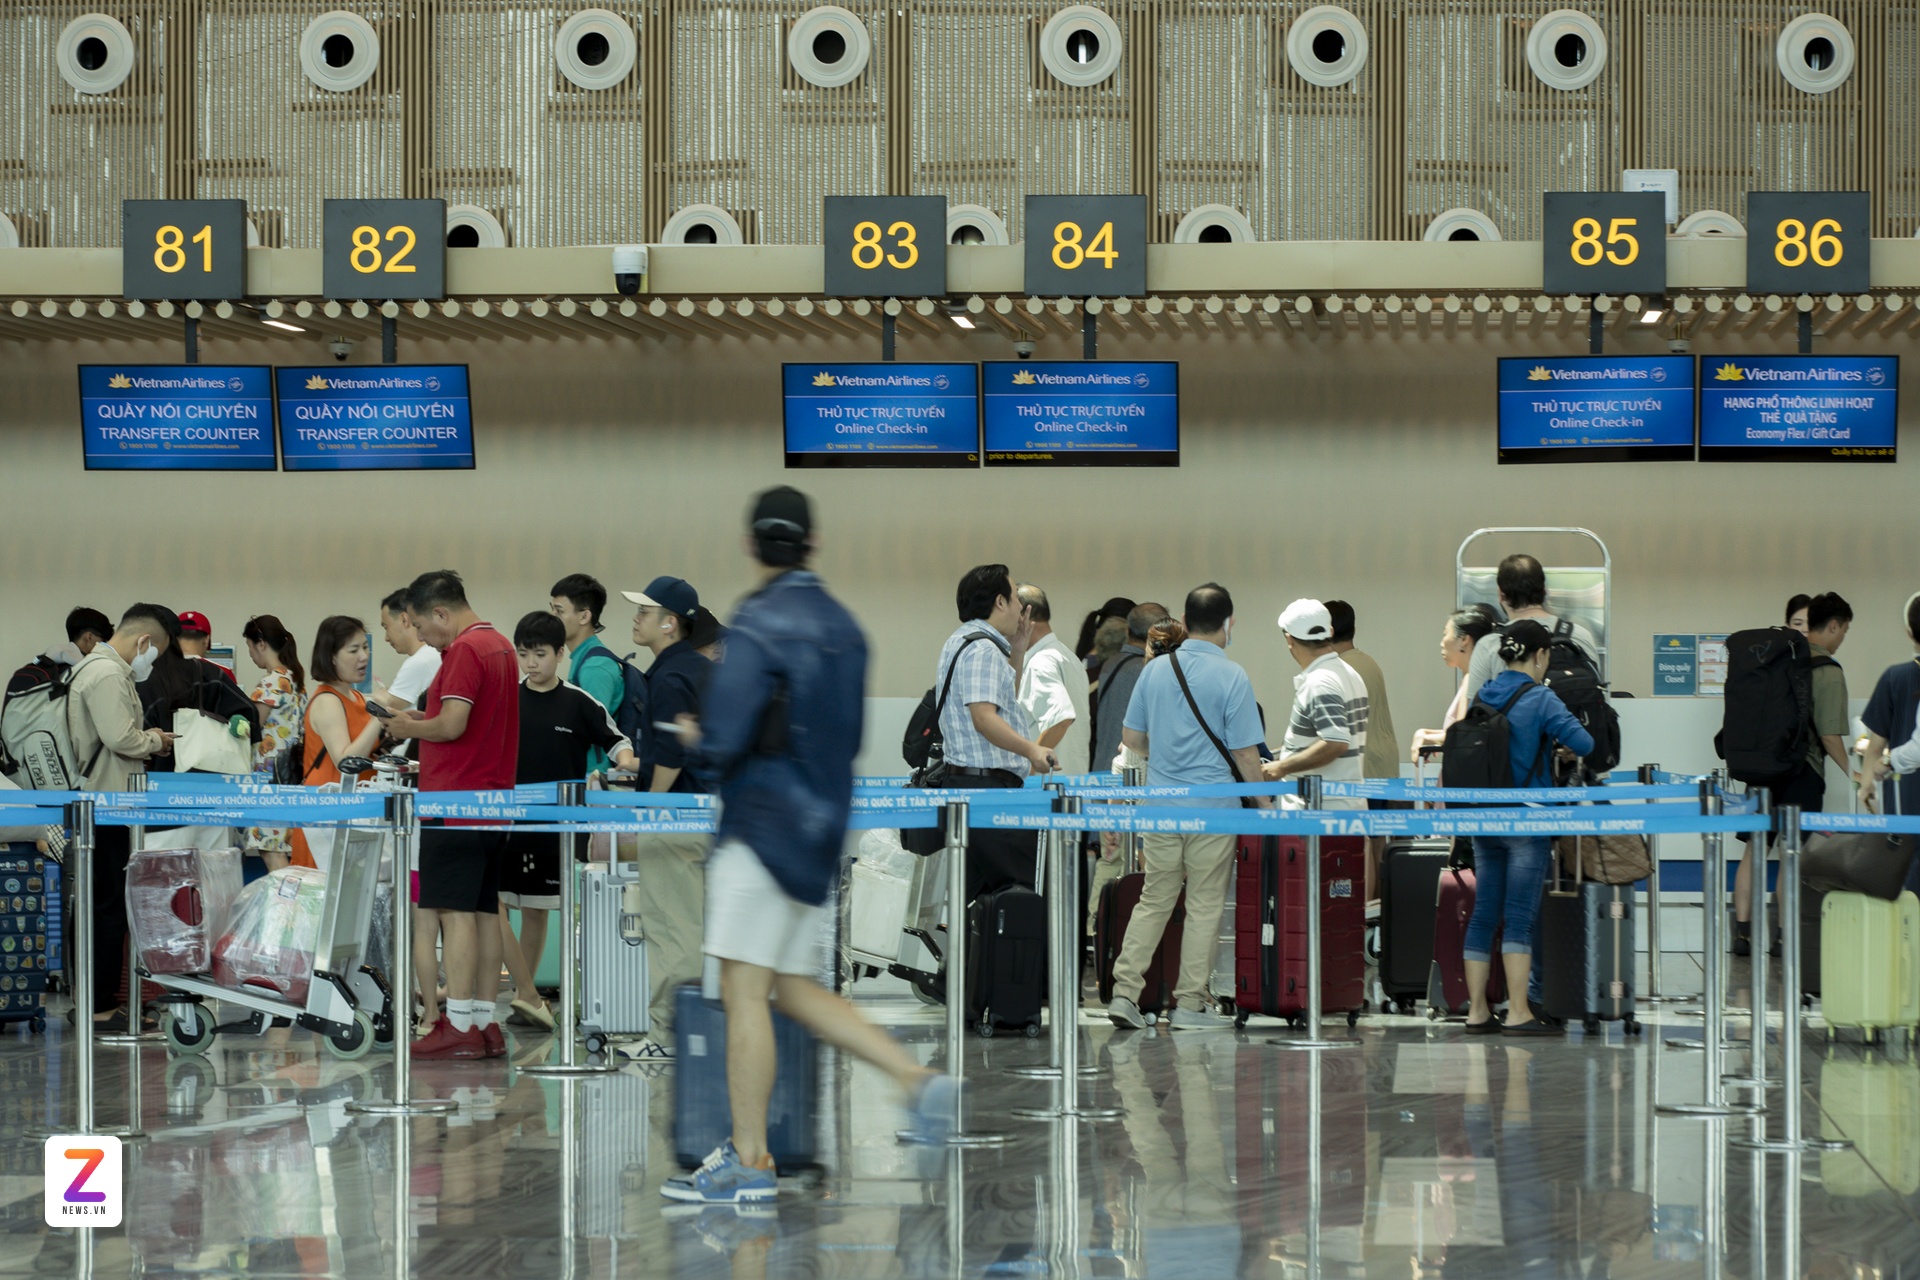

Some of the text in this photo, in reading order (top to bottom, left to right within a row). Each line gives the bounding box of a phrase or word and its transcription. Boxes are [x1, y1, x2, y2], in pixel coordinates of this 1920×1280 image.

[851, 221, 919, 269] 83
[1051, 221, 1119, 269] 84
[1570, 218, 1640, 266] 85
[1774, 218, 1844, 267] 86
[153, 225, 212, 273] 81
[349, 225, 417, 273] 82
[1531, 399, 1558, 413] THỦ
[1559, 401, 1585, 414] TỤC
[1621, 398, 1662, 412] TUYẾN
[1723, 397, 1755, 411] HẠNG
[1780, 395, 1818, 409] THÔNG
[1819, 397, 1844, 409] LINH
[1845, 397, 1875, 411] HOẠT
[816, 405, 842, 418] THỦ
[844, 407, 869, 420] TỤC
[905, 405, 946, 418] TUYẾN
[1016, 403, 1042, 417] THỦ
[1044, 405, 1069, 419] TỤC
[1104, 403, 1145, 417] TUYẾN
[1783, 410, 1807, 425] QUÀ
[835, 423, 928, 434] Online Check-in
[1034, 421, 1128, 432] Online Check-in
[1550, 416, 1644, 429] Online Check-in
[99, 427, 260, 440] TRANSFER COUNTER
[296, 427, 458, 441] TRANSFER COUNTER
[1746, 427, 1785, 441] Economy
[1787, 427, 1806, 439] Flex
[1811, 427, 1829, 439] Gift
[1829, 427, 1851, 439] Card
[988, 453, 1005, 461] prior
[1664, 675, 1686, 683] Closed
[221, 775, 254, 784] TIA
[865, 779, 887, 787] NHAT
[1065, 775, 1100, 786] TIA
[238, 784, 273, 794] TIA
[1076, 788, 1147, 797] INTERNATIONAL
[1148, 787, 1191, 797] AIRPORT
[1321, 782, 1347, 796] TIA
[1403, 789, 1588, 799] TAN SON NHAT INTERNATIONAL AIRPORT
[77, 793, 109, 806] TIA
[224, 795, 255, 806] KHÔNG
[259, 794, 286, 806] QUỐC
[287, 794, 298, 805] TẾ
[300, 795, 318, 805] TÂN
[341, 794, 366, 805] NHẤT
[475, 792, 506, 805] TIA
[693, 794, 717, 807] TI
[870, 795, 894, 808] QUỐC
[897, 795, 907, 807] TẾ
[909, 796, 927, 807] TÂN
[418, 803, 443, 815] QUỐC
[446, 804, 458, 816] TẾ
[461, 805, 479, 817] TÂN
[503, 807, 527, 818] NHẤT
[631, 809, 674, 822] TIA
[1526, 810, 1574, 819] AIRPORT
[1052, 815, 1087, 829] KHÔNG
[1088, 816, 1116, 830] QUỐC
[1118, 817, 1132, 830] TẾ
[1134, 818, 1155, 830] TÂN
[1180, 818, 1207, 832] NHẤT
[1320, 819, 1368, 836] TIA
[1432, 820, 1646, 832] TAN SON NHAT INTERNATIONAL AIRPORT
